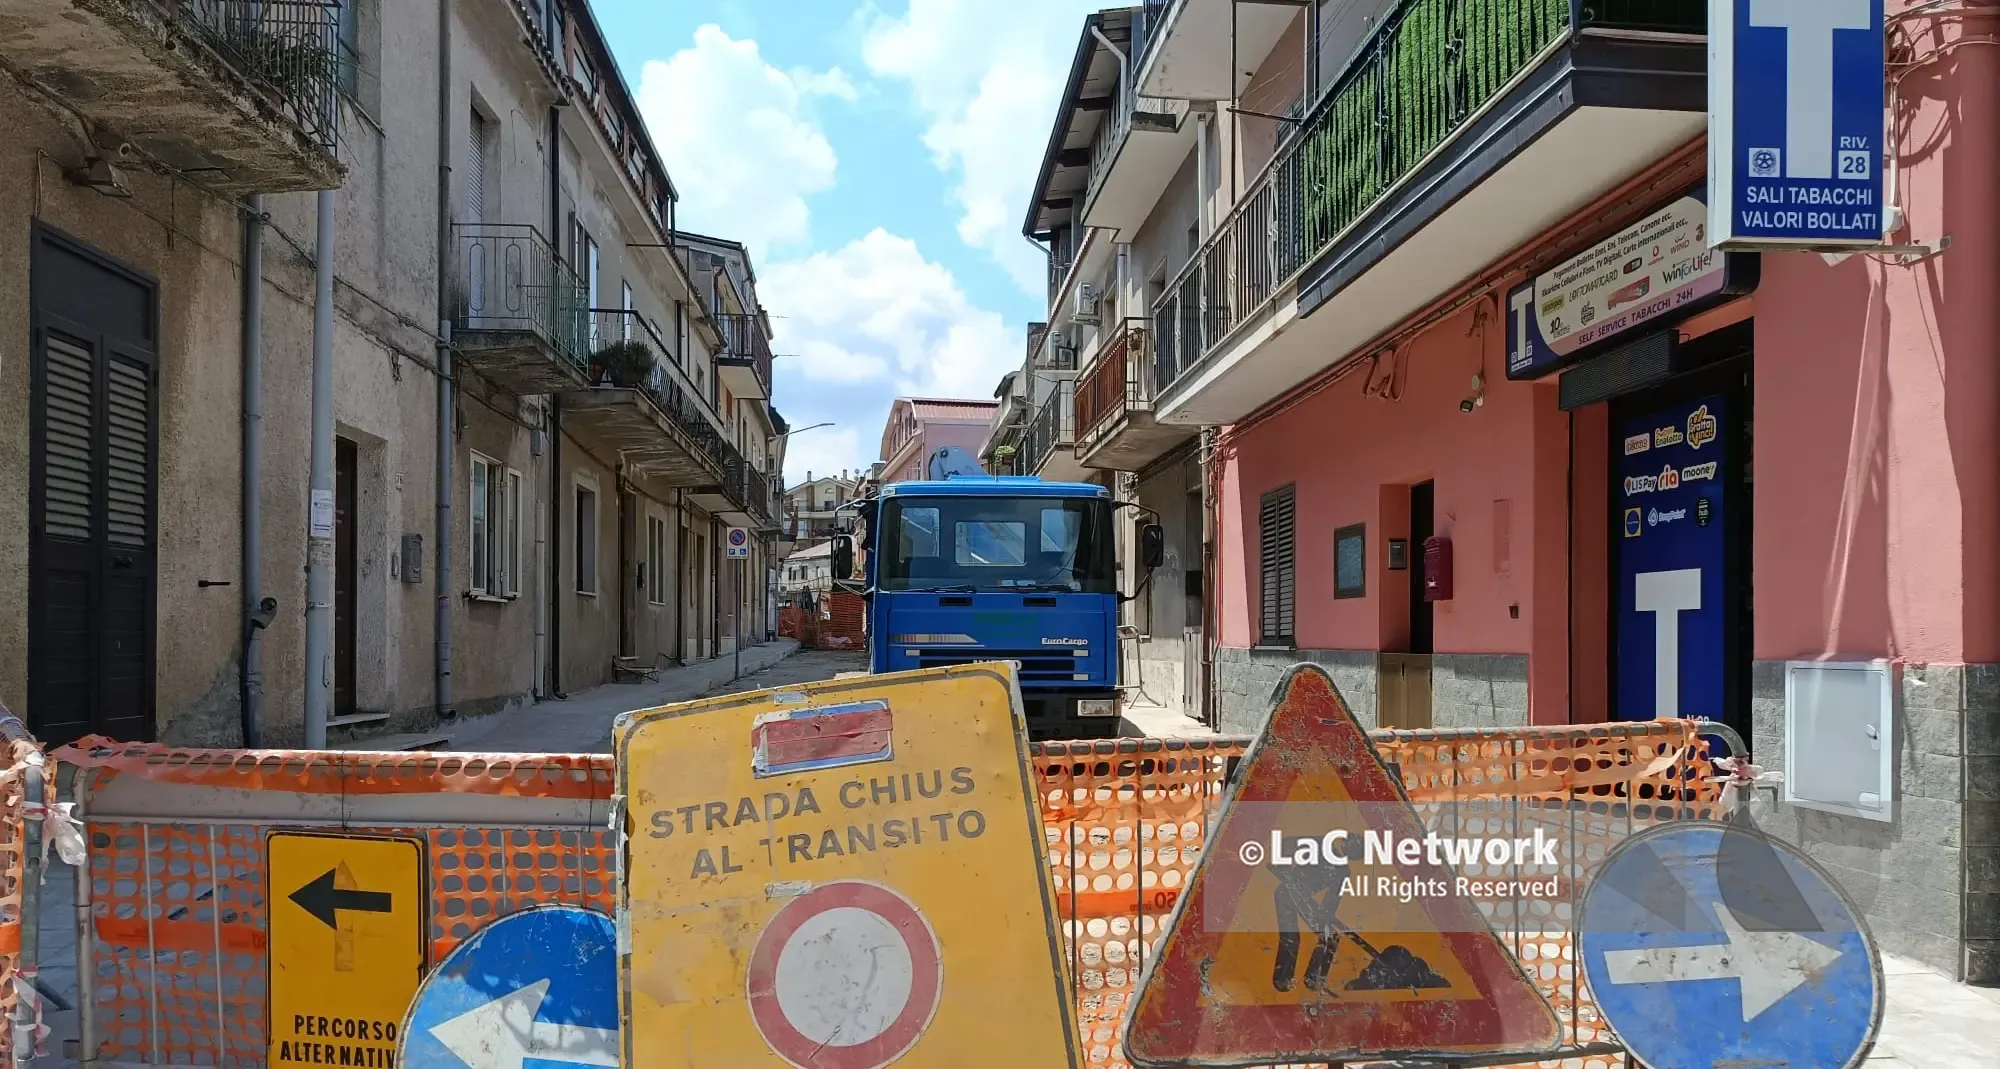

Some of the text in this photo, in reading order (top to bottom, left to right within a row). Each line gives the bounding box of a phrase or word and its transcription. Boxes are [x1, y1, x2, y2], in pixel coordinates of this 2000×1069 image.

[1840, 136, 1869, 149] RIV.
[1843, 156, 1866, 174] 28
[1746, 186, 1872, 205] SALI TABACCHI
[1742, 211, 1876, 230] VALORI BOLLATI
[1670, 239, 1690, 255] WIND
[1578, 331, 1594, 345] SELF
[1598, 317, 1628, 338] SERVICE
[1631, 298, 1671, 323] TABACCHI
[1675, 287, 1694, 304] 24H
[1660, 467, 1677, 488] ria
[1684, 463, 1715, 479] mooney
[1042, 637, 1088, 645] EuroCargo
[649, 767, 975, 839] STRADA CHIUS
[690, 810, 986, 879] AL TRANSITO
[294, 1014, 397, 1042] PERCORSO
[280, 1041, 396, 1069] ALTERNATIV
